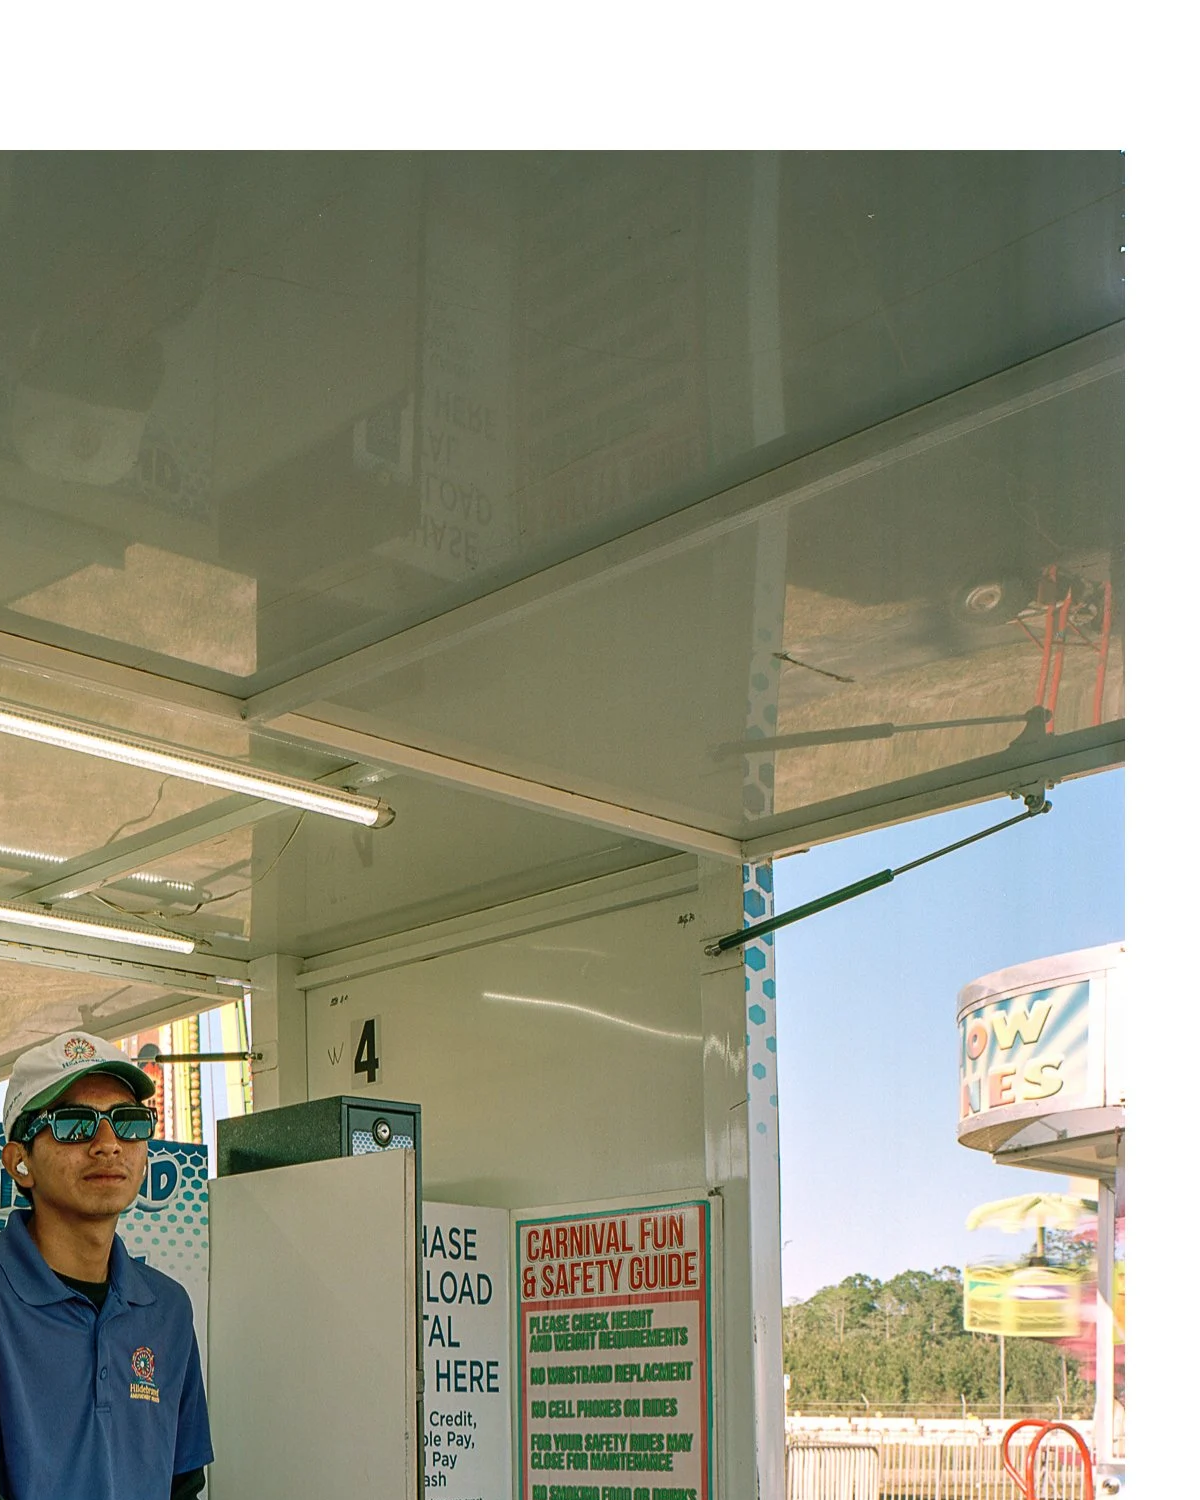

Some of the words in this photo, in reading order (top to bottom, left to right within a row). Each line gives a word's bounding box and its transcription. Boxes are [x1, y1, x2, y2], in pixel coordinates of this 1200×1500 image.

[958, 1000, 1053, 1061] OW
[354, 1018, 380, 1084] 4
[526, 1220, 633, 1263] CARNIVAL
[640, 1214, 684, 1250] FUN
[426, 1270, 493, 1305] LOAD
[522, 1267, 537, 1300] &
[541, 1259, 623, 1298] SAFETY
[629, 1251, 697, 1291] GUIDE
[529, 1314, 570, 1335] PLEASE
[571, 1311, 610, 1332] CHECK
[611, 1308, 654, 1329] HEIGHT
[529, 1333, 552, 1353] AND
[554, 1331, 597, 1352] WEIGHT
[598, 1326, 689, 1350] REQUIREMENTS
[435, 1359, 500, 1393] HERE
[530, 1366, 546, 1385] NO
[547, 1363, 613, 1385] WRISTBAND
[429, 1410, 477, 1429] Credit,
[531, 1399, 547, 1419] NO
[548, 1399, 575, 1419] CELL
[576, 1398, 622, 1418] PHONES
[623, 1398, 640, 1418] ON
[642, 1397, 678, 1418] RIDES
[447, 1431, 475, 1449] Pay,
[530, 1433, 552, 1451] FOR
[553, 1433, 583, 1451] YOUR
[584, 1433, 628, 1452] SAFETY
[629, 1433, 665, 1452] RIDES
[666, 1433, 693, 1453] MAY
[432, 1451, 458, 1469] Pay
[530, 1452, 565, 1471] CLOSE
[566, 1452, 589, 1471] FOR
[590, 1452, 674, 1472] MAINTENANCE
